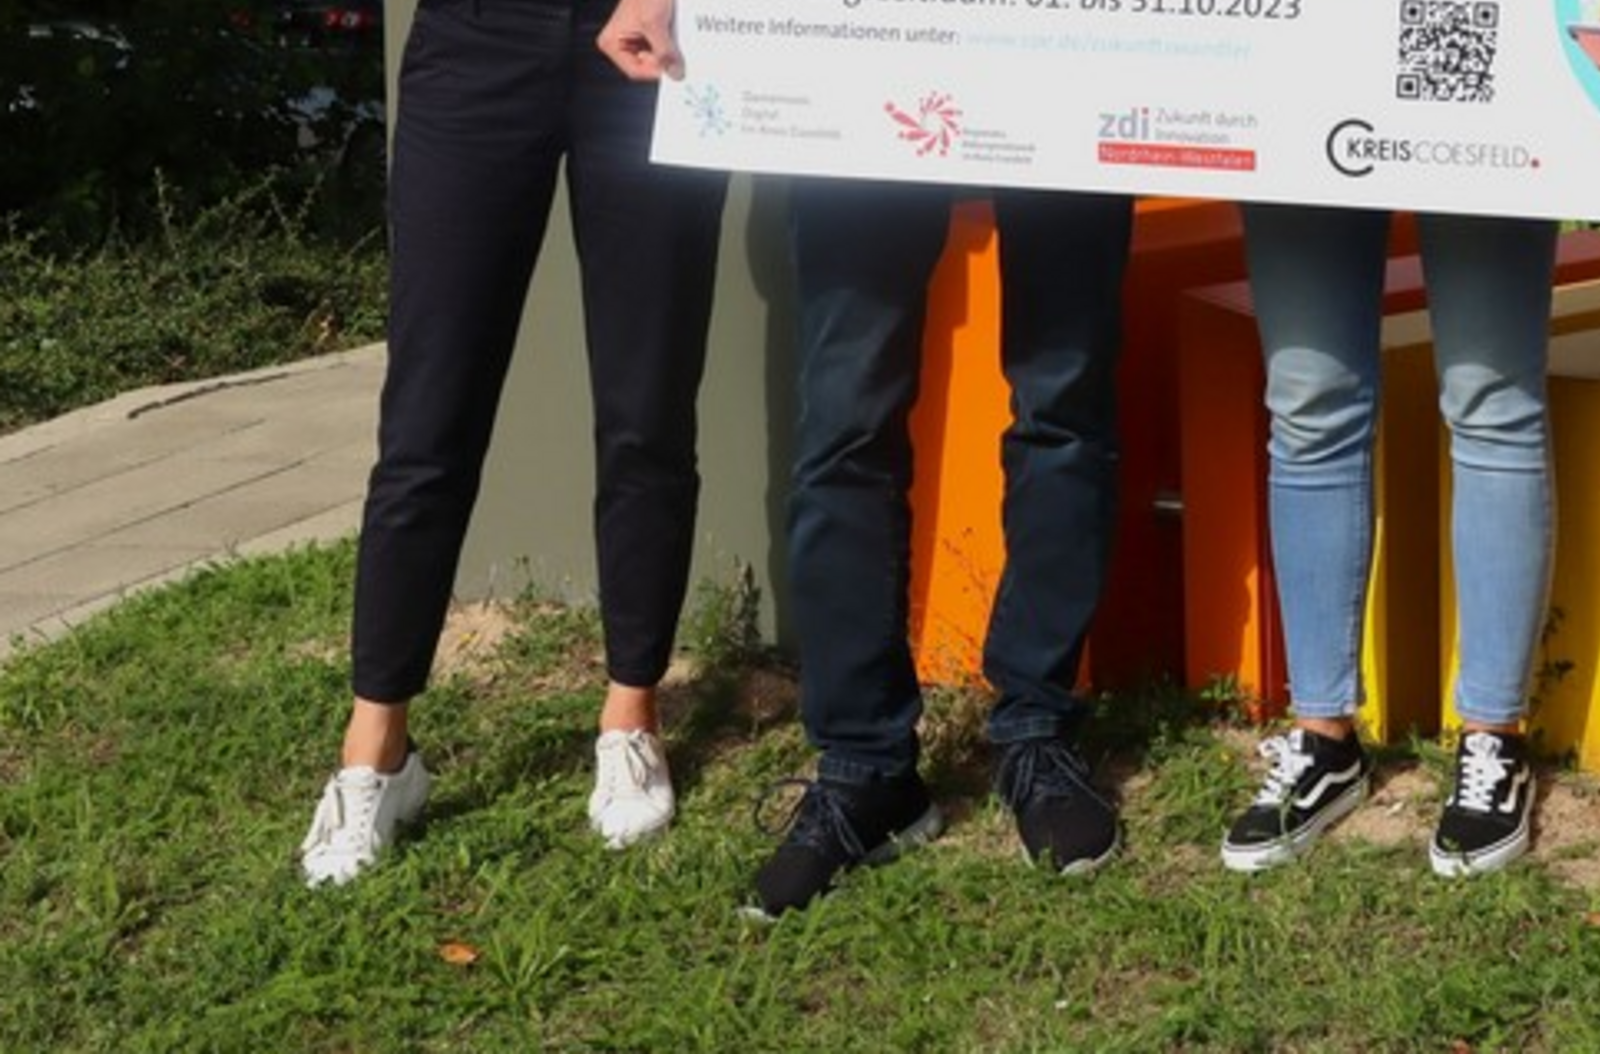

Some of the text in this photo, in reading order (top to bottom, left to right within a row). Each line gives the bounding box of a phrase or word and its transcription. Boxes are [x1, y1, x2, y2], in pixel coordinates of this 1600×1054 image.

[696, 16, 960, 45] Weitere Informationen unter:
[1098, 107, 1150, 141] zdi
[1154, 106, 1258, 129] Zukunft durch
[1155, 127, 1231, 145] Innovation
